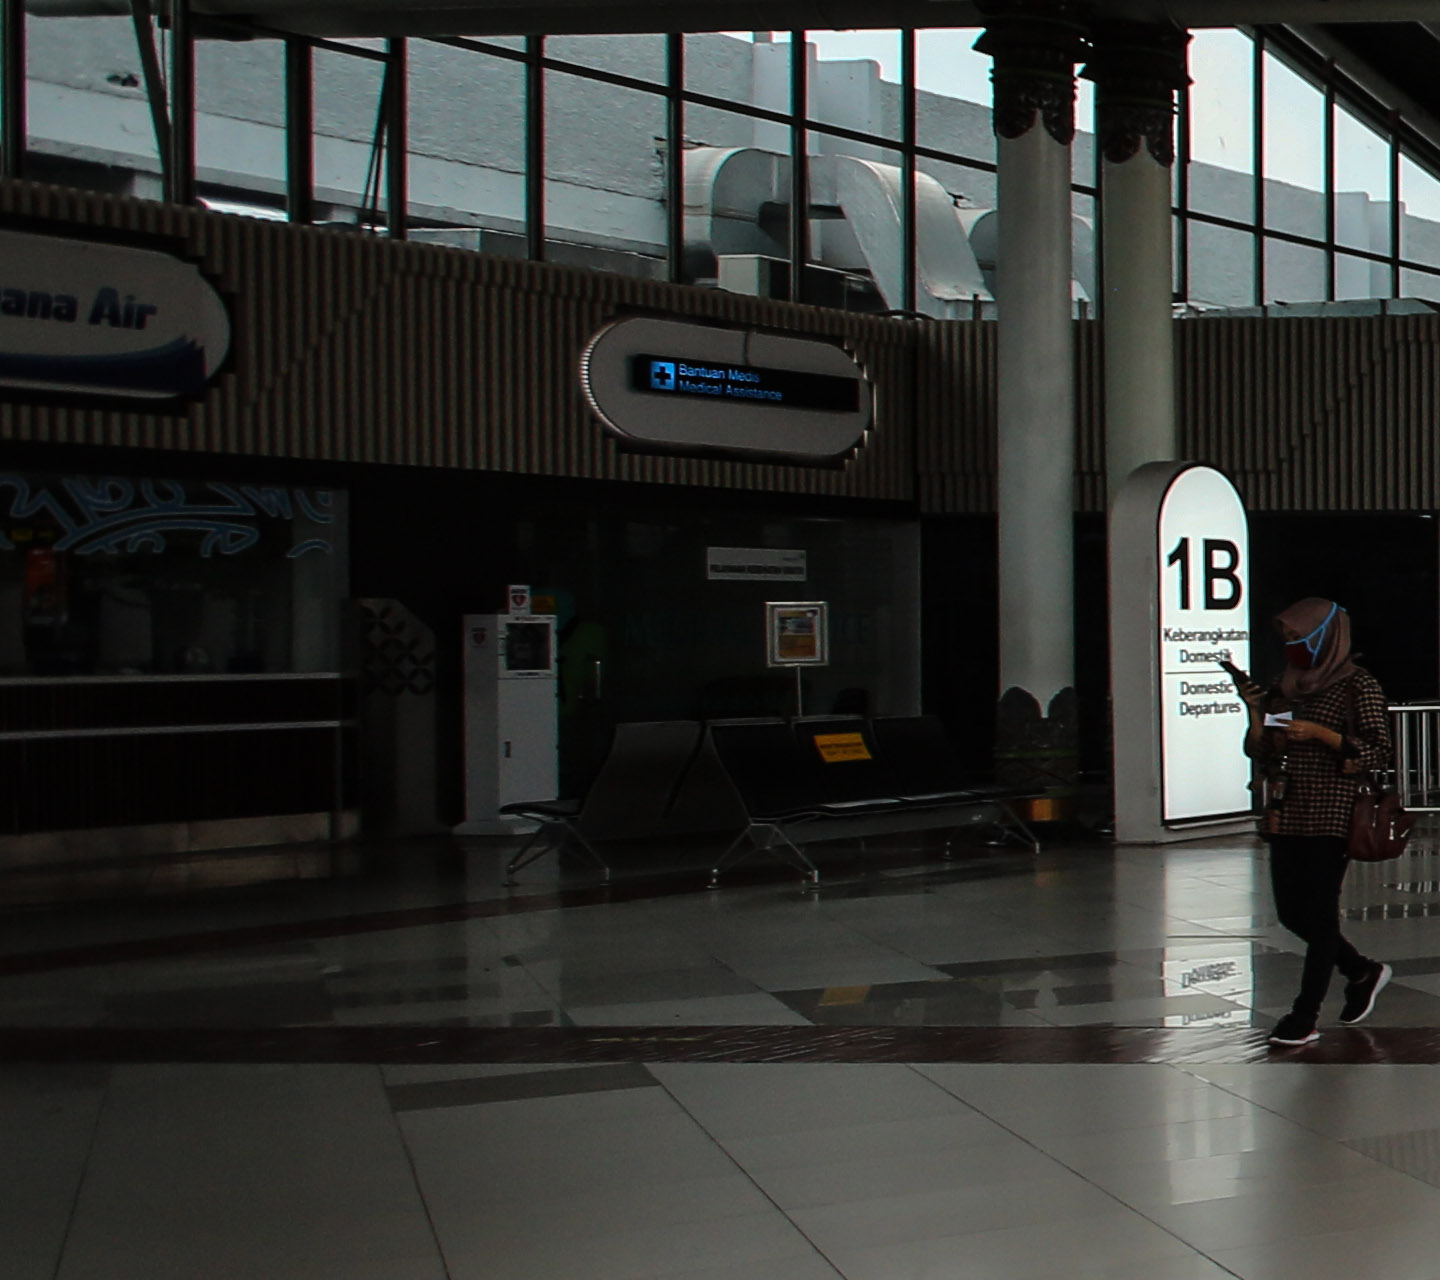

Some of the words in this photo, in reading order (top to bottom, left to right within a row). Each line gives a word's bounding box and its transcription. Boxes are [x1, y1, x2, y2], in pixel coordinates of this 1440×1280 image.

[0, 288, 78, 322] ana
[88, 286, 157, 330] Air
[678, 363, 725, 380] Bantuan
[728, 368, 760, 384] Medis
[678, 380, 722, 396] Medical
[725, 385, 784, 401] Assistance
[1167, 537, 1242, 610] 1B
[1163, 627, 1248, 644] Keberangkatan
[1179, 648, 1232, 663] Domestik
[1180, 680, 1233, 696] Domestic
[1179, 700, 1241, 718] Departures
